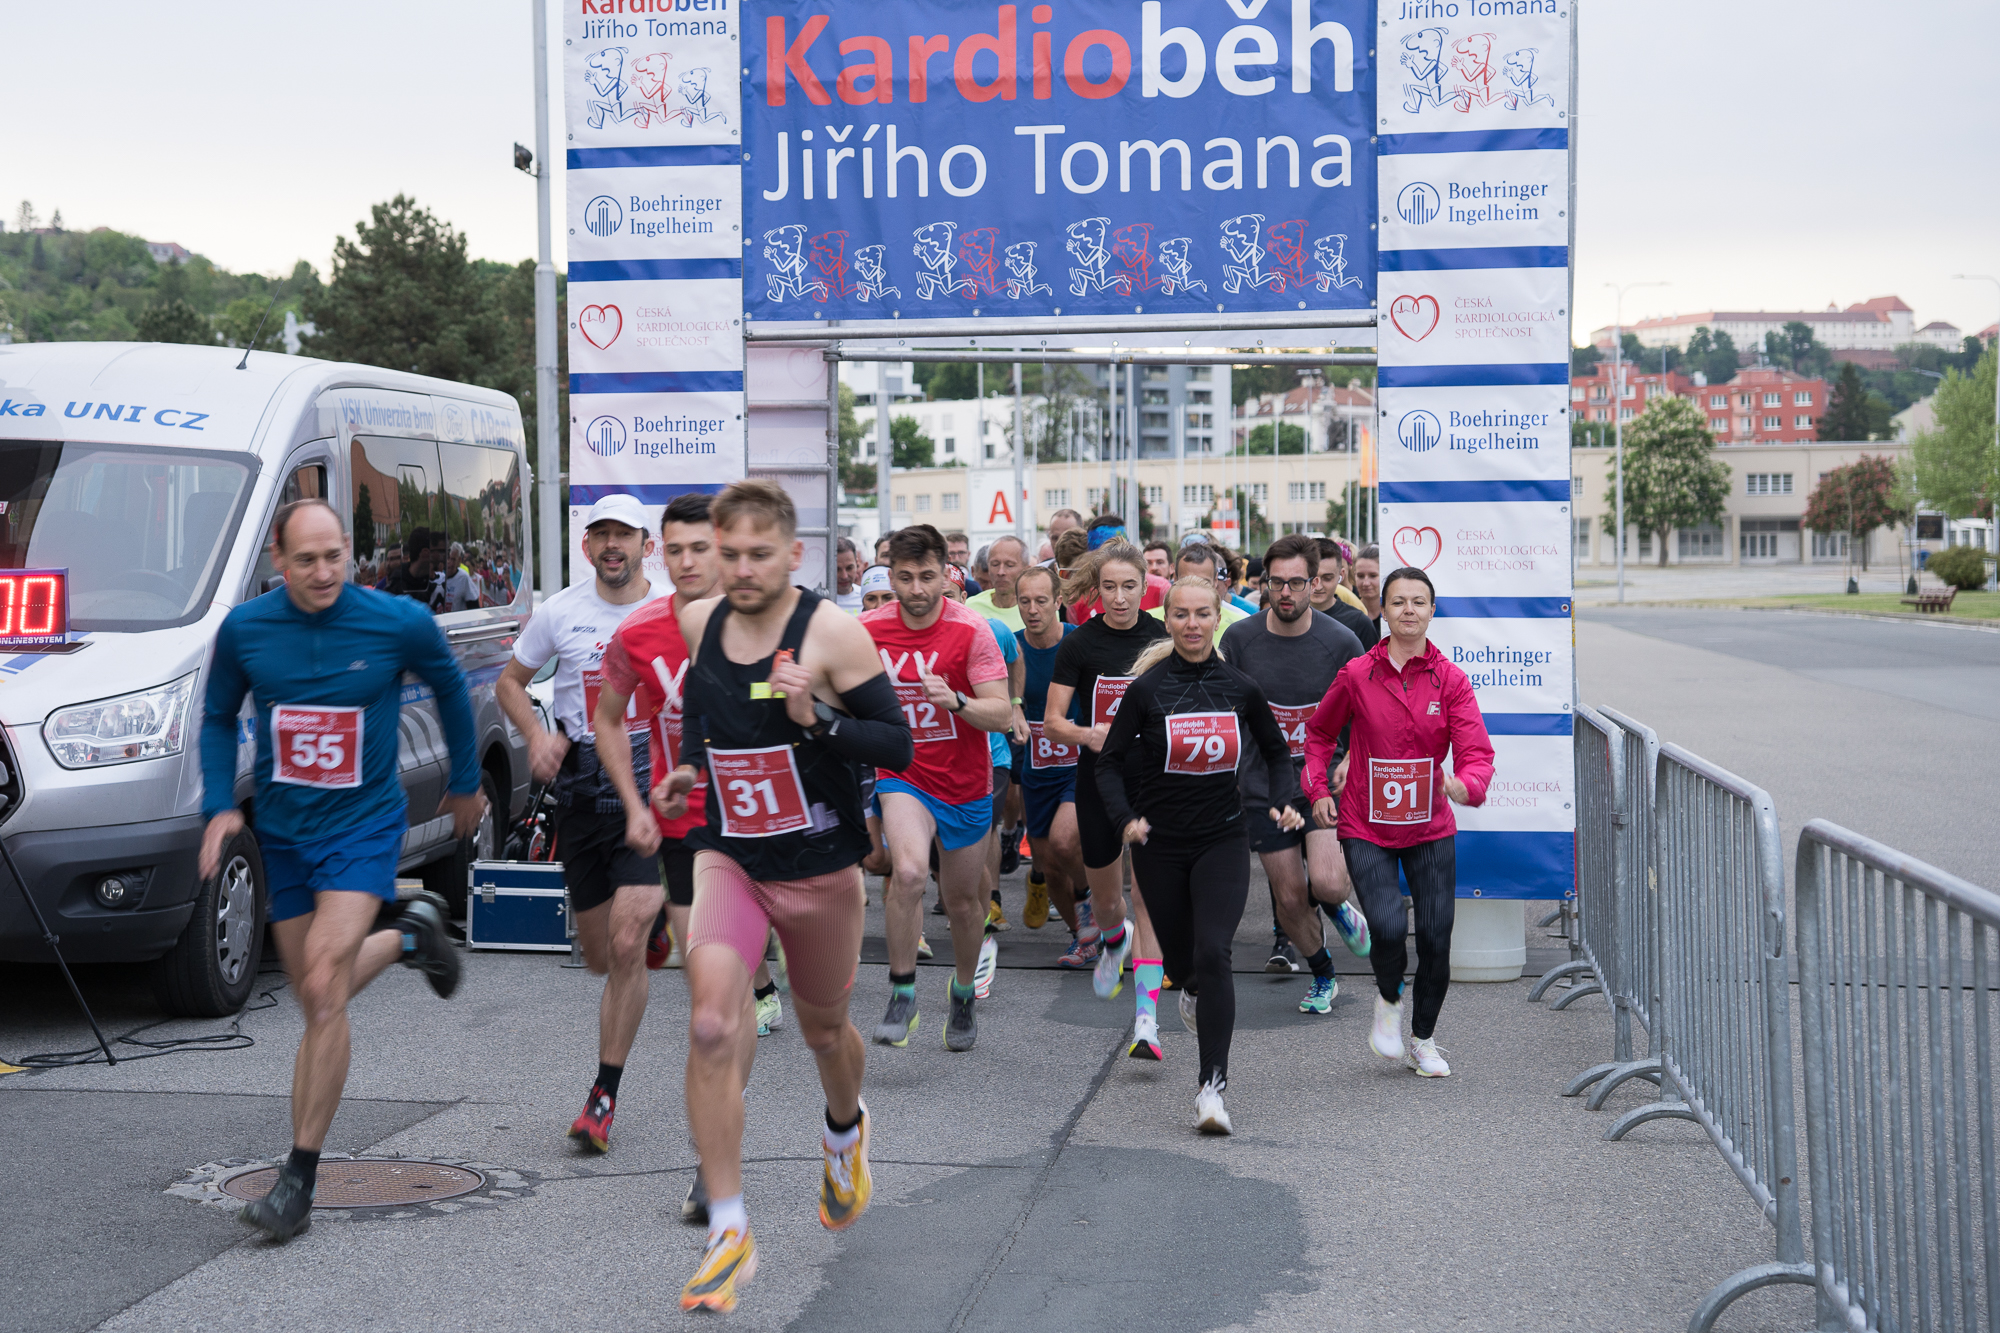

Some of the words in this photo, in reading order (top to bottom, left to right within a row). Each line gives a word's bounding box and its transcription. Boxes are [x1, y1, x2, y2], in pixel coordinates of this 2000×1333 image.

[1468, 0, 1557, 17] Tomana
[582, 19, 638, 39] Jiřího
[644, 18, 727, 37] Tomana
[764, 0, 1355, 107] Kardioběh
[763, 124, 988, 202] Jiřího
[1014, 124, 1353, 195] Tomana
[1448, 180, 1548, 201] Boehringer
[629, 195, 723, 215] Boehringer
[1448, 203, 1539, 225] Ingelheim
[630, 217, 714, 238] Ingelheim
[636, 306, 673, 319] ČESKÁ
[1454, 296, 1493, 309] ČESKÁ
[636, 320, 731, 333] KARDIOLOGICKÁ
[1454, 311, 1556, 324] KARDIOLOGICKÁ
[636, 335, 710, 348] SPOLEČNOST
[1454, 326, 1534, 340] SPOLEČNOST
[63, 401, 147, 423] UNI
[153, 409, 210, 431] CZ
[339, 397, 363, 425] VSK
[365, 401, 413, 429] Univerzita
[414, 405, 435, 431] Brno
[1449, 410, 1549, 430] Boehringer
[633, 415, 726, 436] Boehringer
[633, 438, 717, 458] Ingelheim
[1449, 432, 1540, 453] Ingelheim
[988, 491, 1014, 524] A
[1456, 528, 1496, 541] ČESKÁ
[1457, 545, 1559, 557] KARDIOLOGICKÁ
[1457, 559, 1536, 571] SPOLEČNOST
[1452, 645, 1553, 667] Boehringer
[1466, 668, 1543, 690] gelheim
[901, 702, 941, 730] 12
[290, 733, 345, 769] 55
[1182, 734, 1226, 763] 79
[1382, 780, 1417, 809] 91
[1486, 780, 1561, 792] DIOLOGICKÁ
[727, 778, 780, 817] 31
[1483, 795, 1539, 807] LEČNOST
